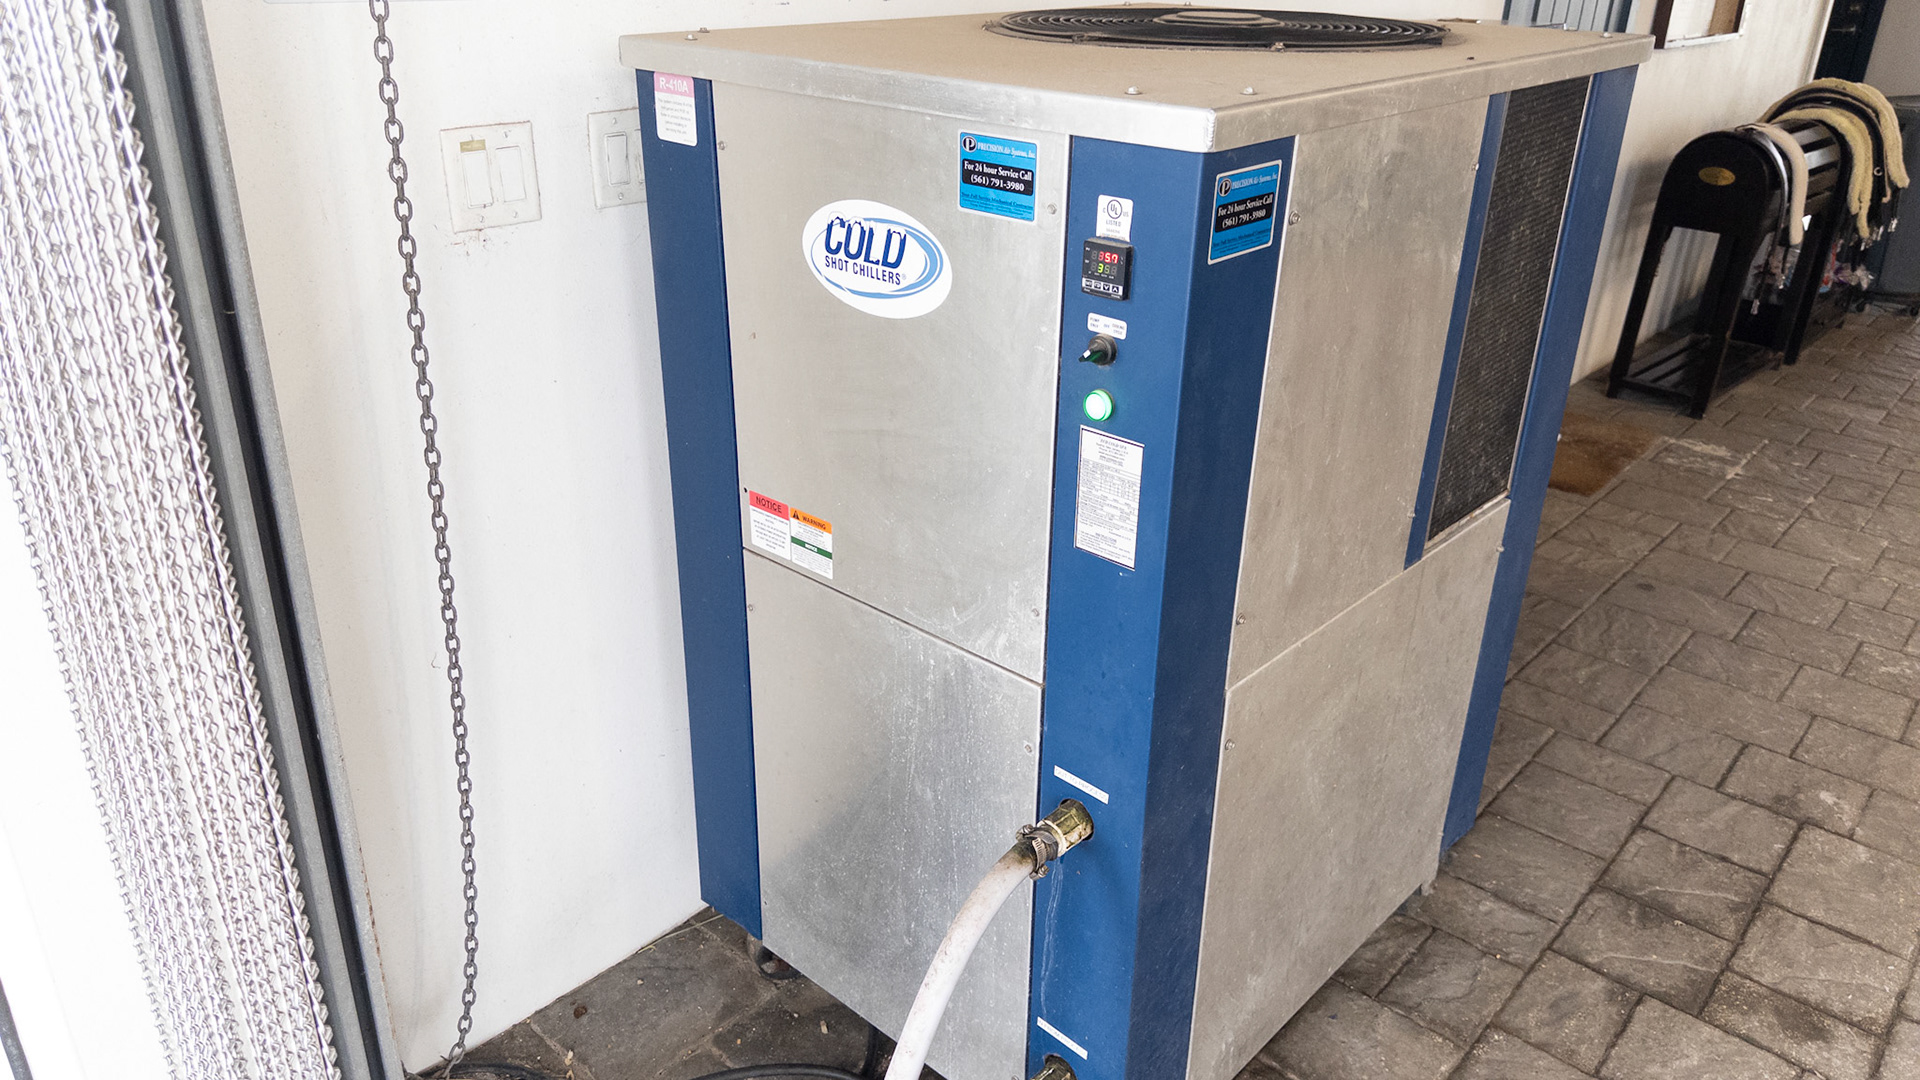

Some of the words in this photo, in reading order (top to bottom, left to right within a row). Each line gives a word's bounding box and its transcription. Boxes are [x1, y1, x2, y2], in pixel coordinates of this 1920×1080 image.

[659, 77, 689, 94] R-410A
[978, 142, 1003, 153] PRECISION
[964, 161, 974, 171] For
[974, 163, 983, 172] 24
[983, 164, 998, 175] hour
[998, 166, 1019, 177] Service
[1019, 170, 1033, 181] Call
[970, 174, 989, 186] (561)
[990, 178, 1025, 191] 791-3980
[1217, 206, 1226, 217] For
[1234, 202, 1246, 213] hour
[1246, 198, 1263, 209] Service
[1262, 193, 1274, 206] Call
[824, 215, 907, 269] COLD
[825, 255, 849, 273] SHOT
[853, 262, 901, 286] CHILLERS
[756, 496, 782, 514] NOTICE
[802, 515, 826, 530] WARNING
